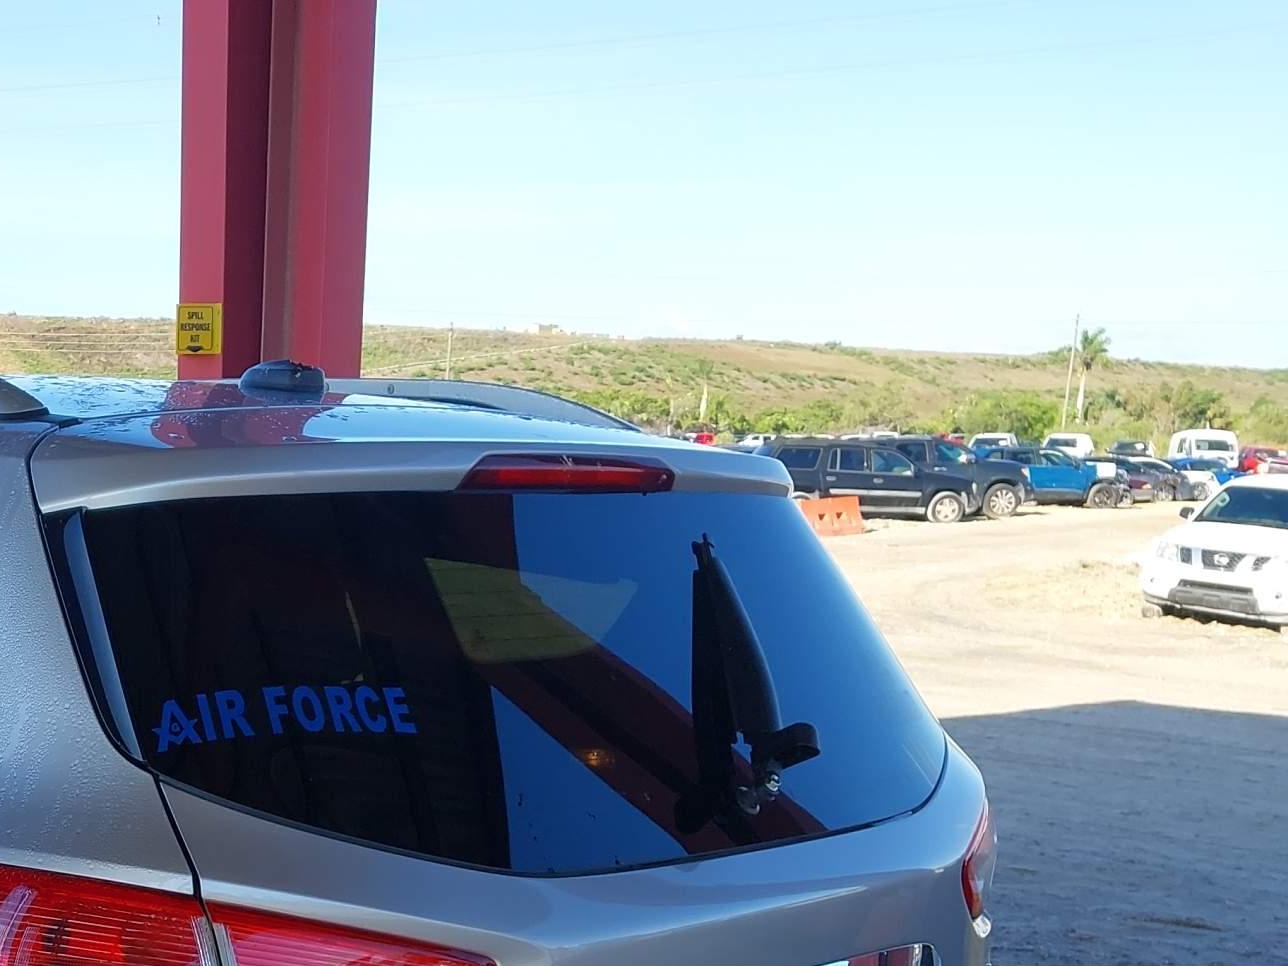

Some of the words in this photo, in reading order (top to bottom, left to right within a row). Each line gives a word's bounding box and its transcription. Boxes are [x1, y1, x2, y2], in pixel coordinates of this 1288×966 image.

[187, 311, 204, 320] SPILL
[180, 322, 211, 331] RESPONSE
[190, 335, 200, 343] KIT
[152, 689, 256, 753] AIR
[262, 685, 418, 735] FORCE
